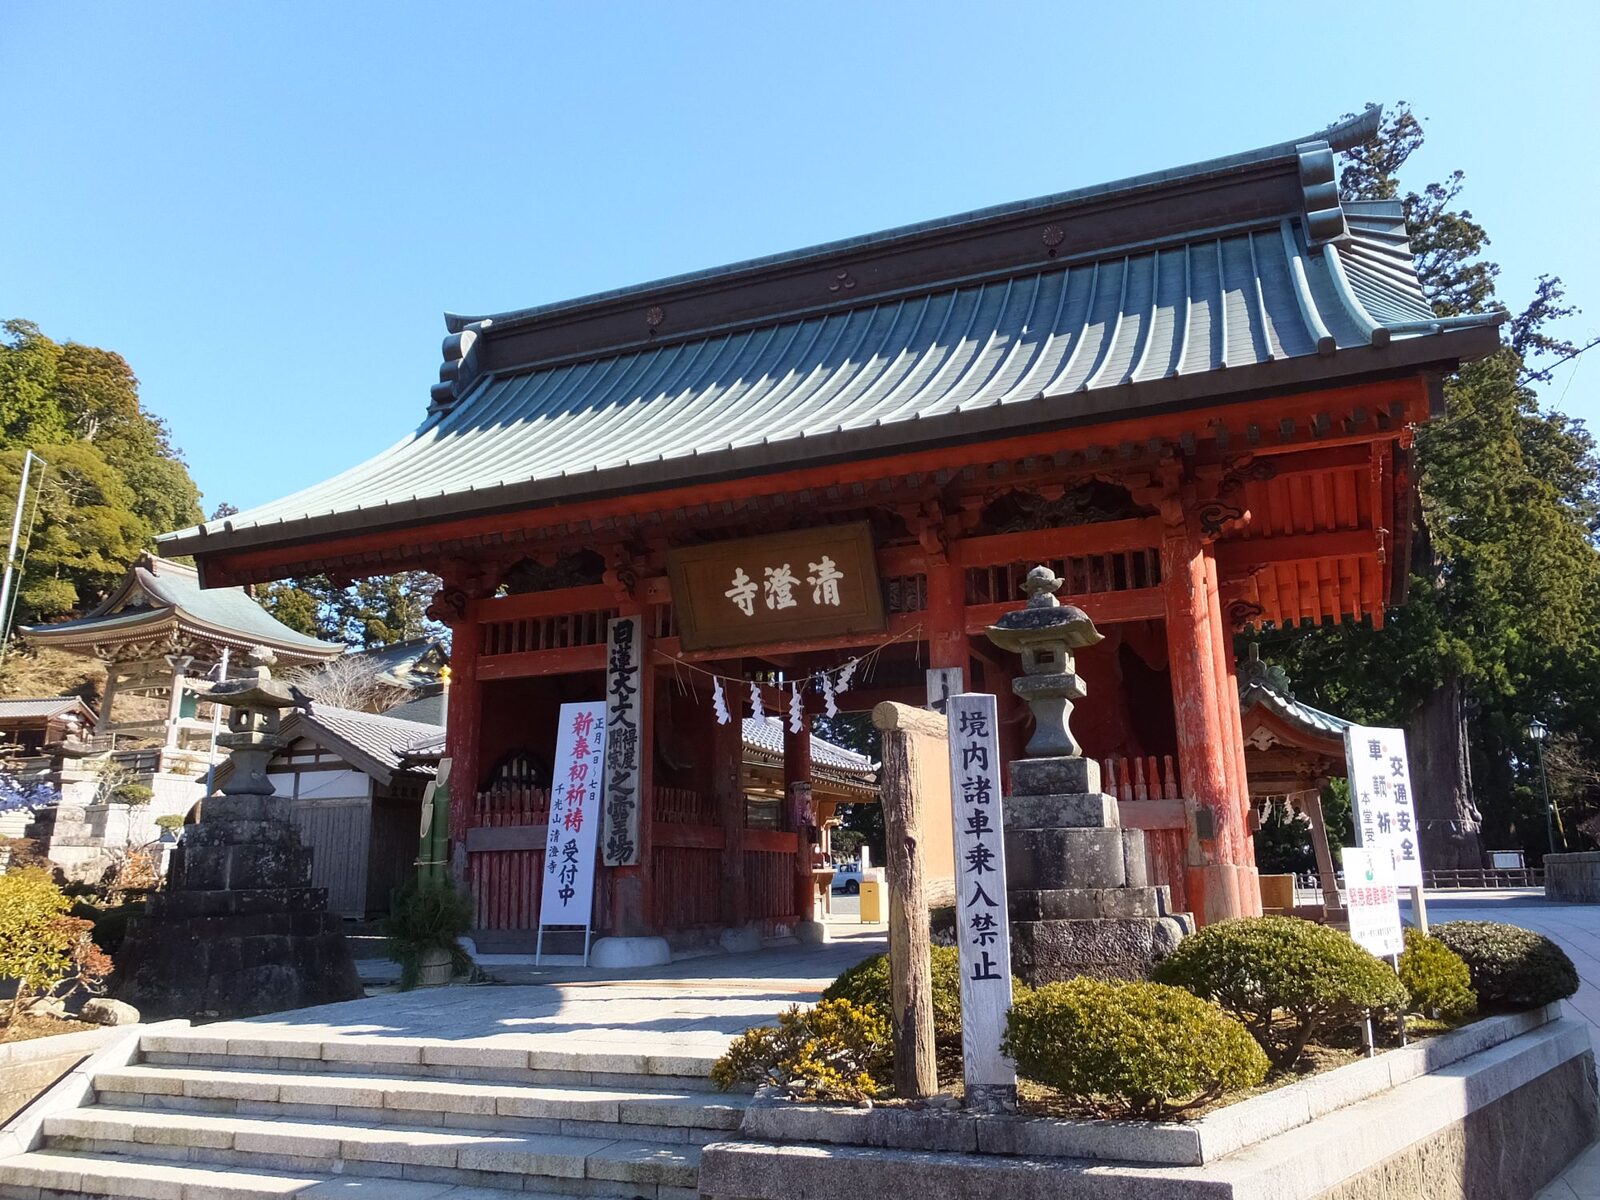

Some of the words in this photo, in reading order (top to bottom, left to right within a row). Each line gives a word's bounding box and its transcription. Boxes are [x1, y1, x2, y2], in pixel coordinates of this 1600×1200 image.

[725, 555, 844, 617] 清澄寺
[608, 618, 638, 729] 日蓮大上人
[563, 711, 594, 834] 新春初祈祷
[621, 728, 638, 770] 得度
[547, 782, 565, 875] 千光山清澄寺
[958, 710, 1003, 982] 境内諸車乗入禁止
[1360, 791, 1377, 849] 本堂受
[1389, 755, 1416, 861] 交通安全
[558, 837, 579, 908] 受付中
